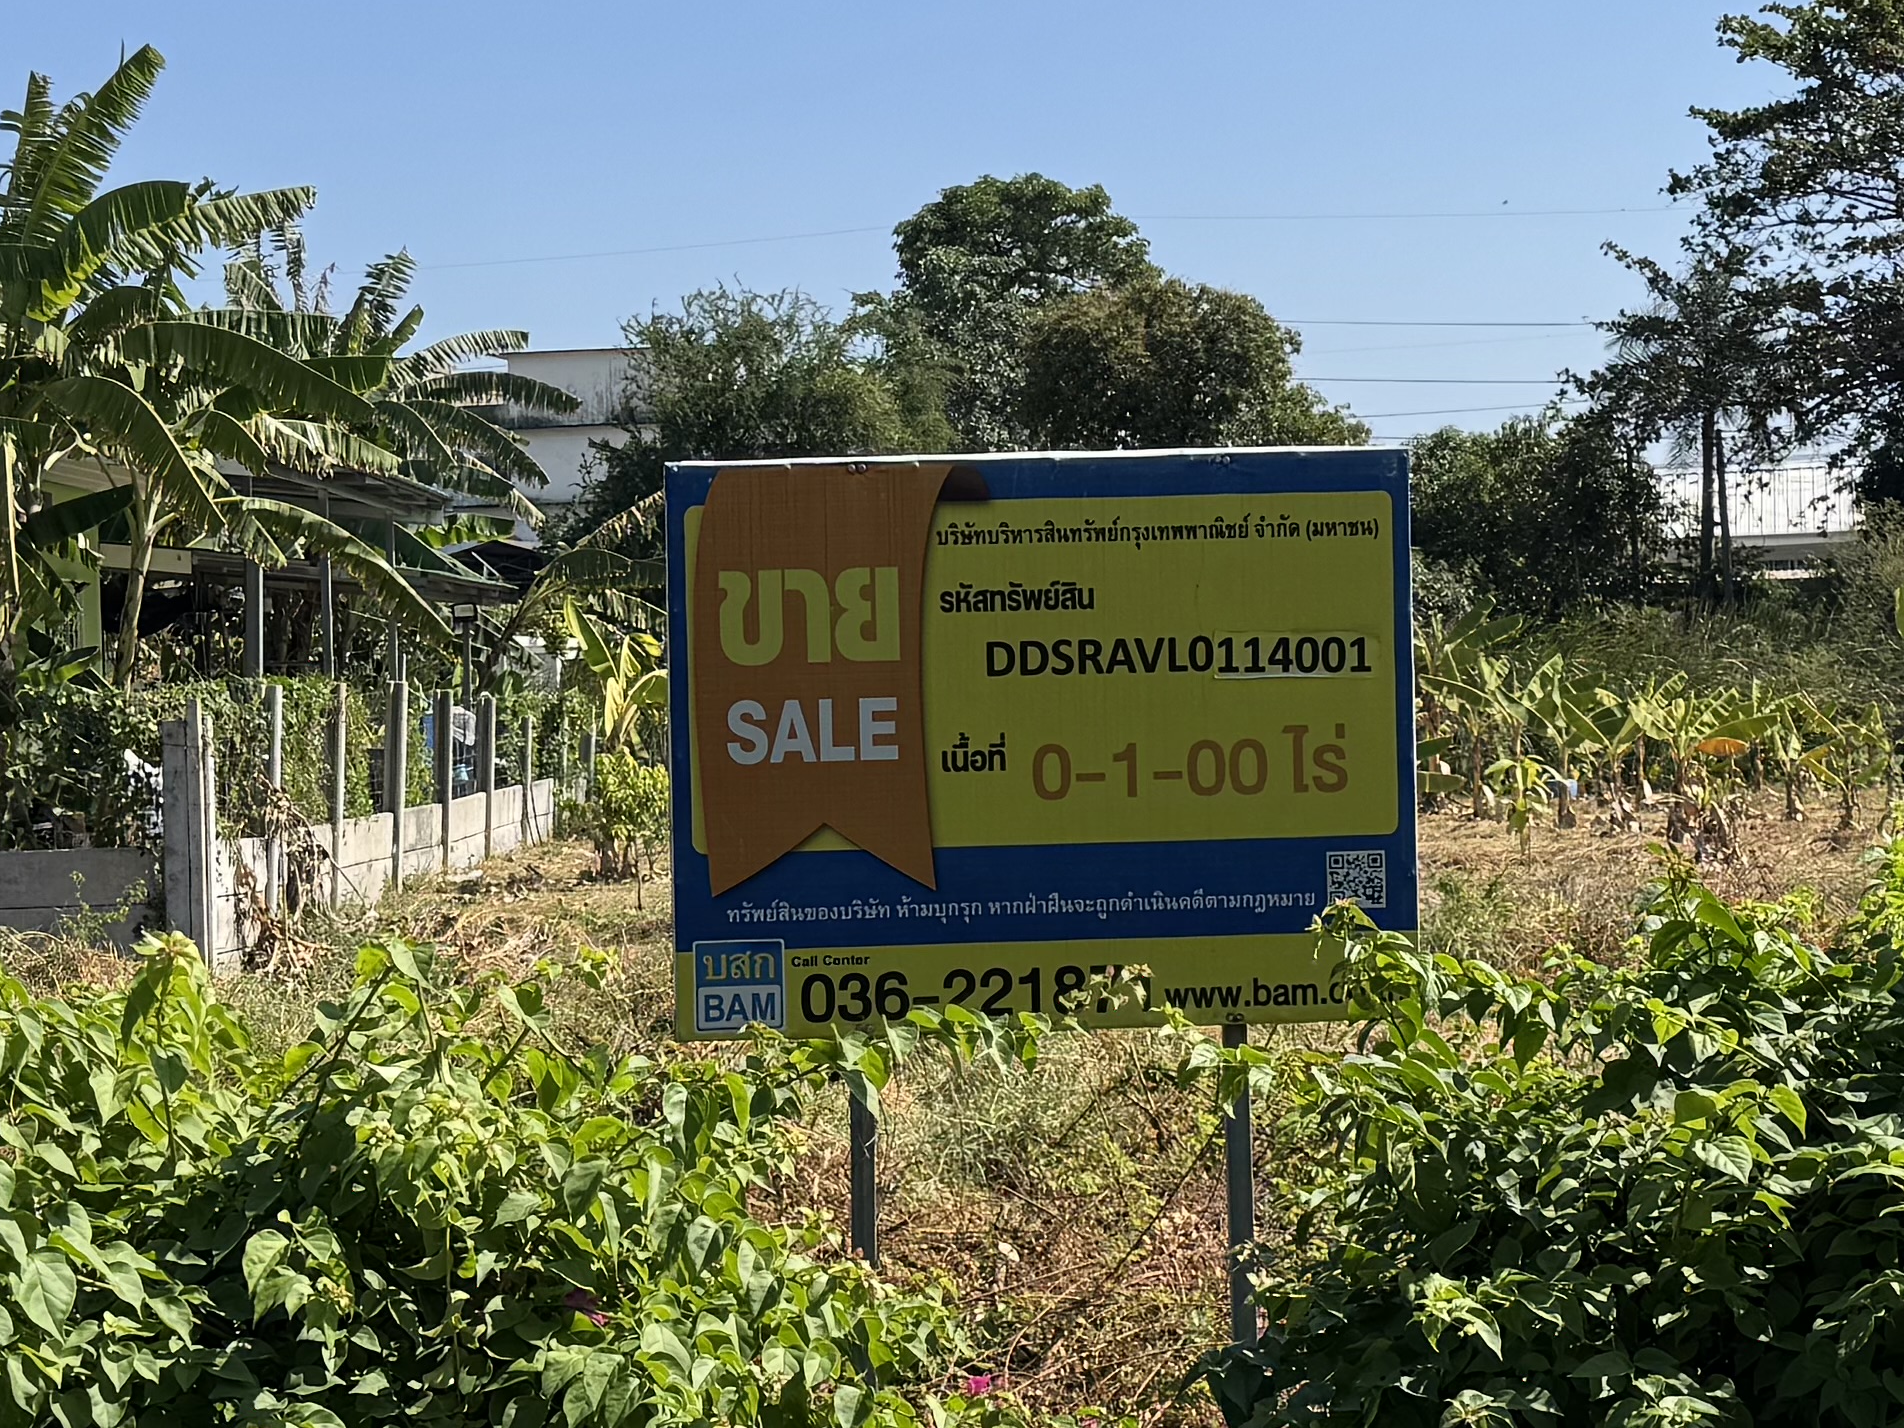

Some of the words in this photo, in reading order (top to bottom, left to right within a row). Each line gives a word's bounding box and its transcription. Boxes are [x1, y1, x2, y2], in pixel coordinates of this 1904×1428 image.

[1254, 514, 1301, 539] จำกัด
[1306, 518, 1380, 541] (มหาชน)
[939, 580, 1094, 613] รหัสทรัพย์สิน
[718, 566, 901, 666] ขาย
[986, 636, 1372, 677] DDSRAVL0114001
[727, 697, 899, 765] SALE
[941, 732, 1007, 773] เนื้อที่
[1032, 738, 1269, 801] 0-1-00
[1282, 722, 1349, 794] ไร่
[727, 898, 891, 923] ทรัพย์สินของบริษัท
[896, 895, 983, 925] ห้ามบุกรุก
[703, 950, 775, 980] บสก
[791, 956, 818, 968] Call
[704, 992, 776, 1022] BAM
